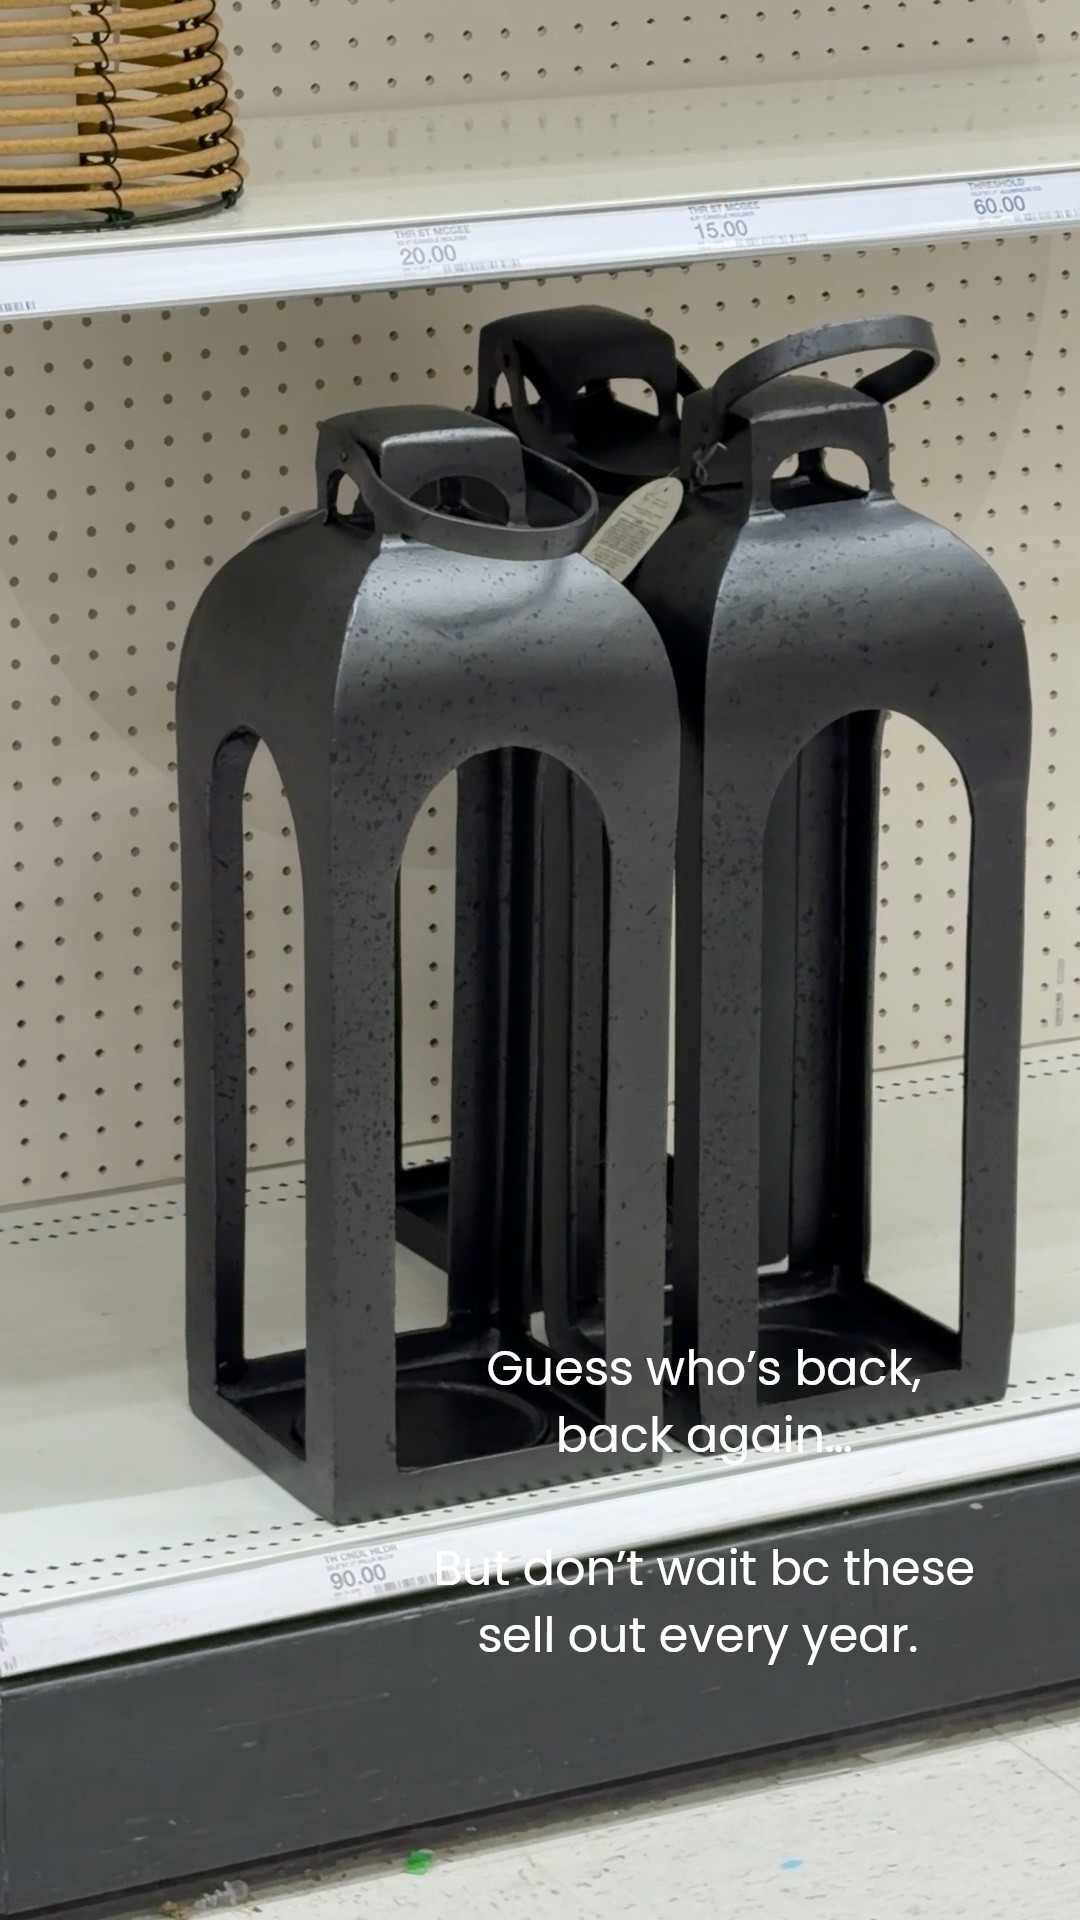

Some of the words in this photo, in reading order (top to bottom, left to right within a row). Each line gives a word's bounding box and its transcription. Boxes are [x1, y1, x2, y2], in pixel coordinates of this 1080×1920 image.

[967, 178, 1025, 190] THRESHOLD
[687, 206, 708, 215] THR
[973, 194, 1026, 215] 60.00
[394, 230, 416, 239] THR
[418, 228, 431, 237] ST
[433, 225, 471, 235] MCGEE
[694, 219, 748, 240] 15.00
[399, 244, 457, 266] 20.00
[324, 1555, 338, 1564] TH
[329, 1563, 387, 1590] 90.00
